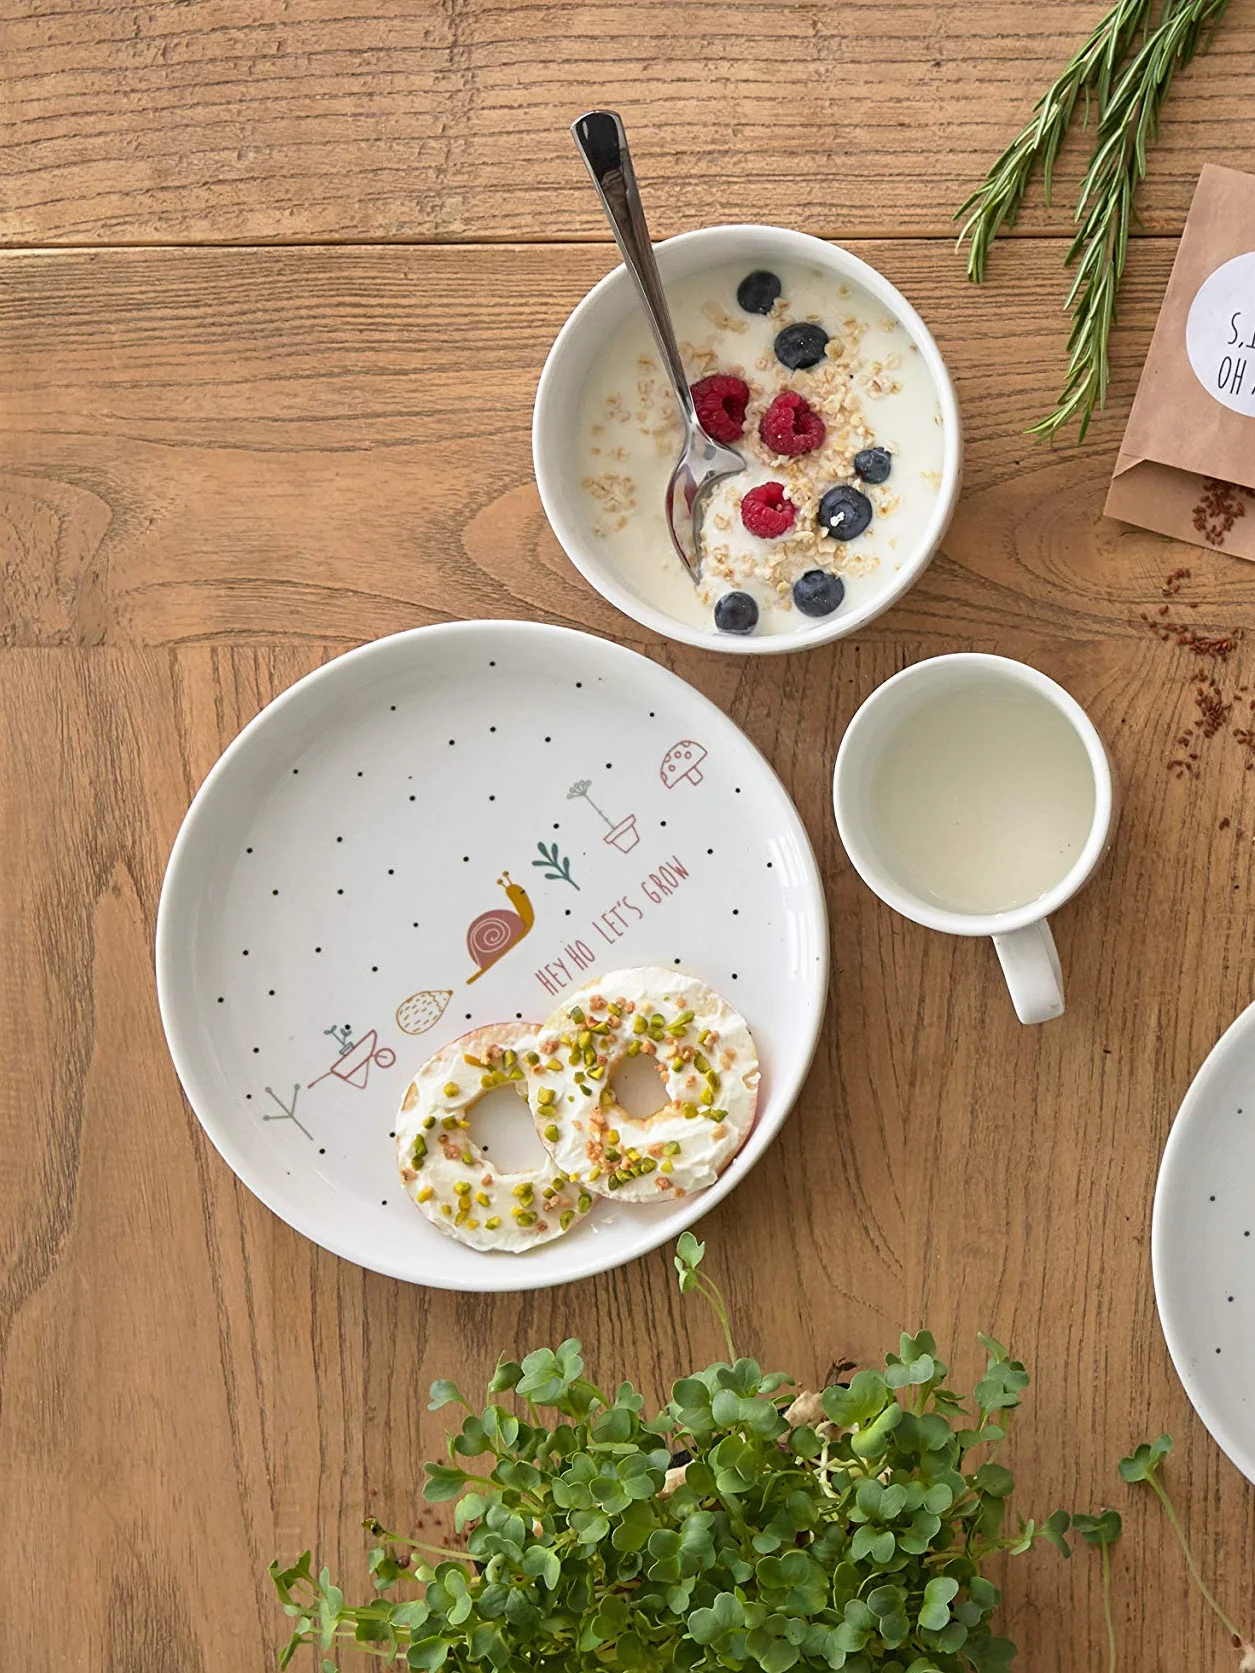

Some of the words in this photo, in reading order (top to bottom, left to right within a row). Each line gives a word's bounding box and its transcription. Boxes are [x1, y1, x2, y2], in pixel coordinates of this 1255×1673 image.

[1217, 355, 1247, 395] HO
[534, 957, 573, 996] HEY
[564, 939, 596, 971] HO
[591, 896, 644, 944] LET'S
[640, 855, 690, 904] GROW
